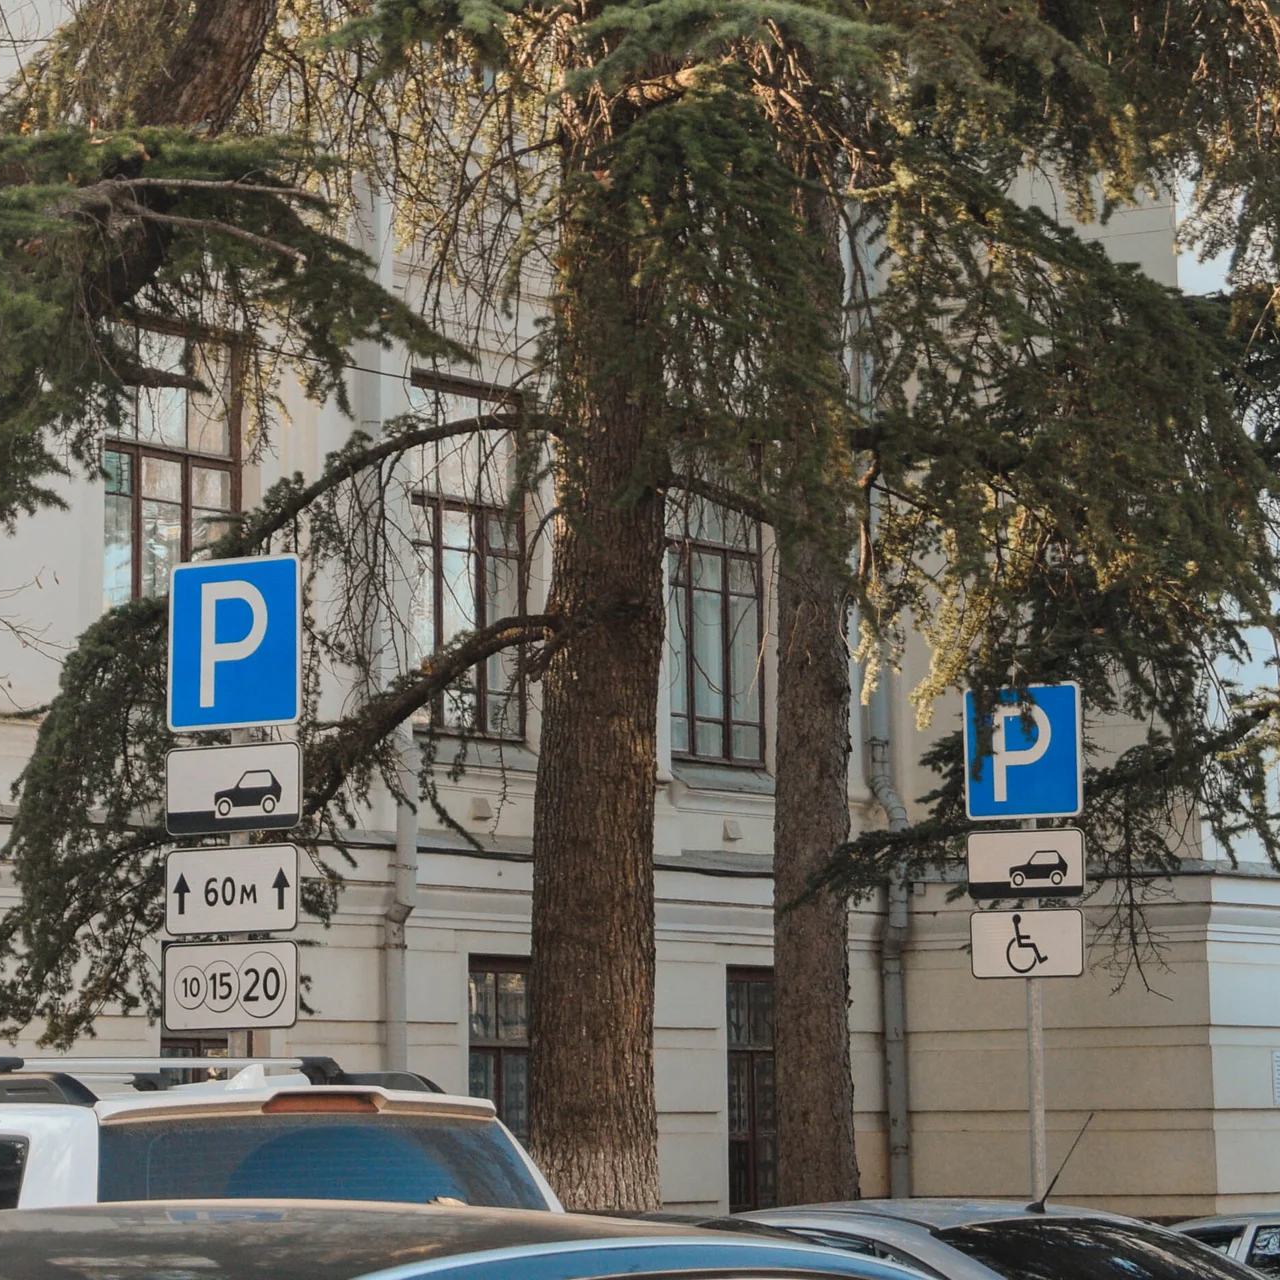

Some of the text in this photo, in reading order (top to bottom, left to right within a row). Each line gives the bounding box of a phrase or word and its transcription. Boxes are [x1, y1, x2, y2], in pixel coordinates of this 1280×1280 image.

[199, 580, 268, 708] P
[992, 700, 1052, 802] P
[182, 967, 280, 1002] 10 15 20
